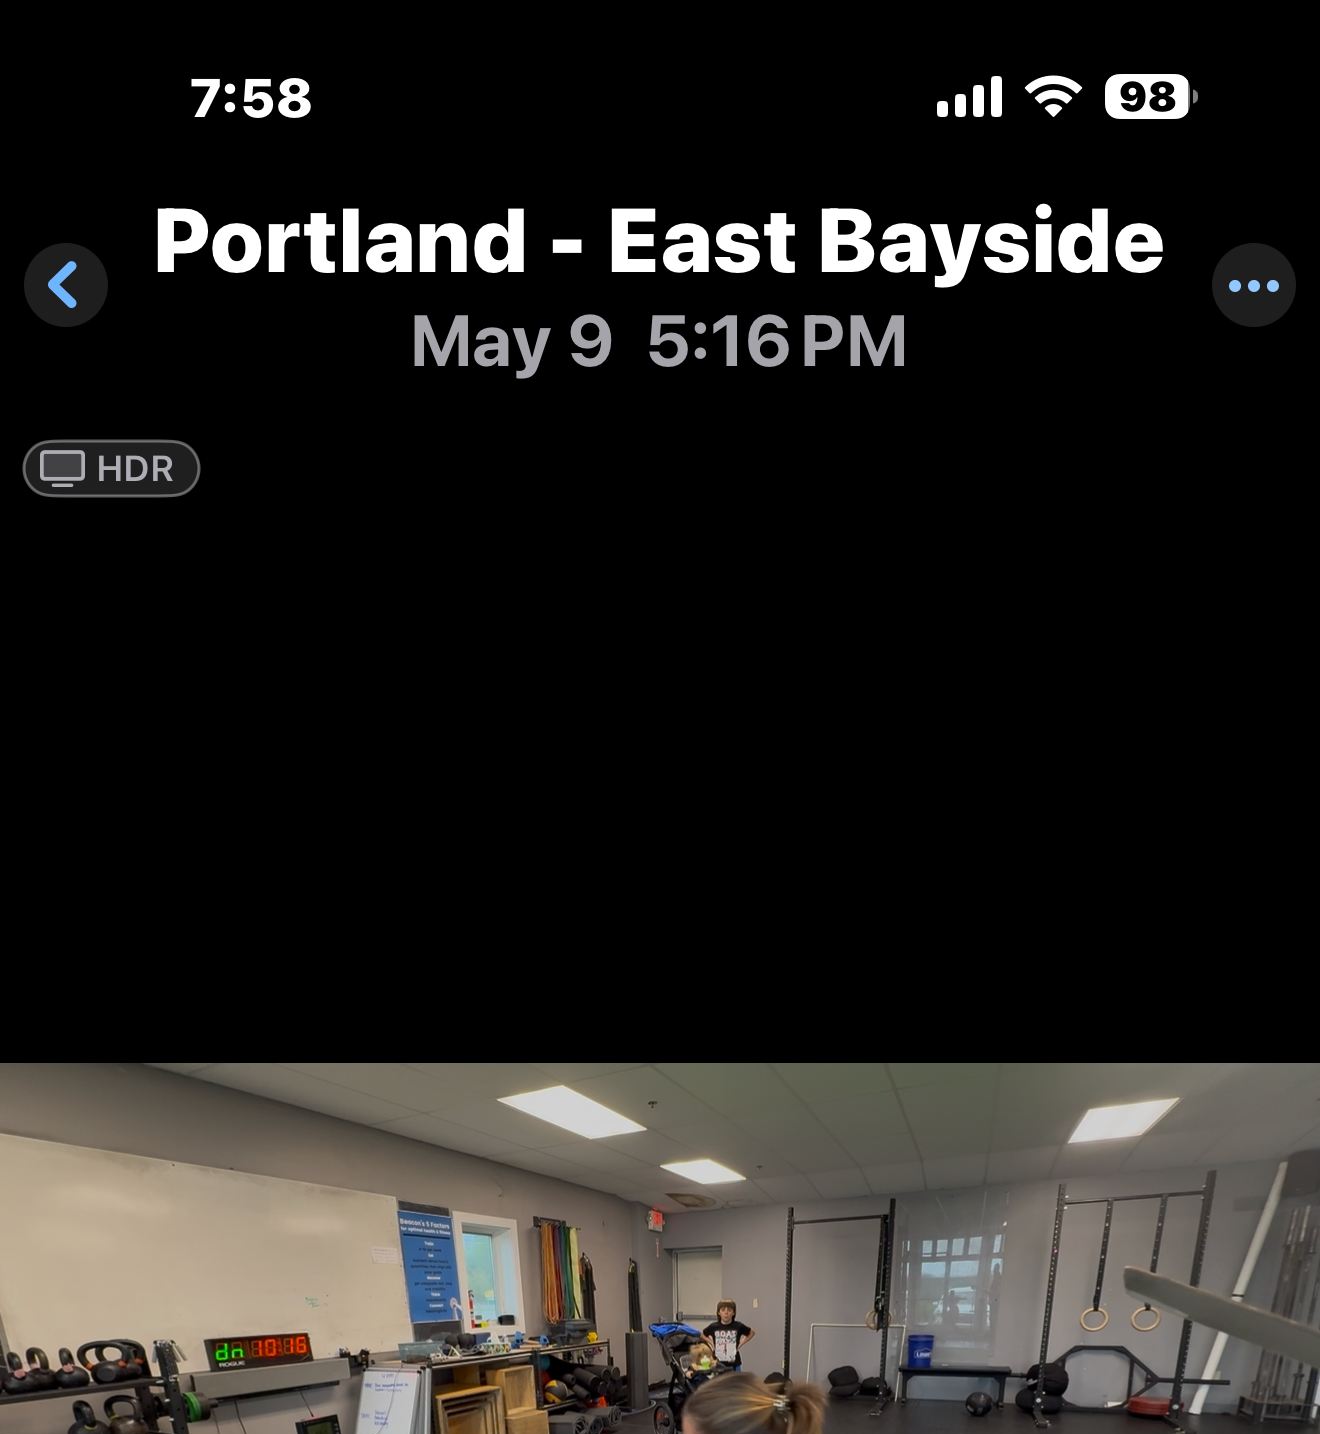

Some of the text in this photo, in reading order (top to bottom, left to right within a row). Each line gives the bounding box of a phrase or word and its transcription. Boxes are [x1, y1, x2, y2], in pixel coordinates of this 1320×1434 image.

[400, 1218, 425, 1227] Beacon's
[257, 1336, 307, 1357] 10:16
[218, 1360, 246, 1368] ROGUE
